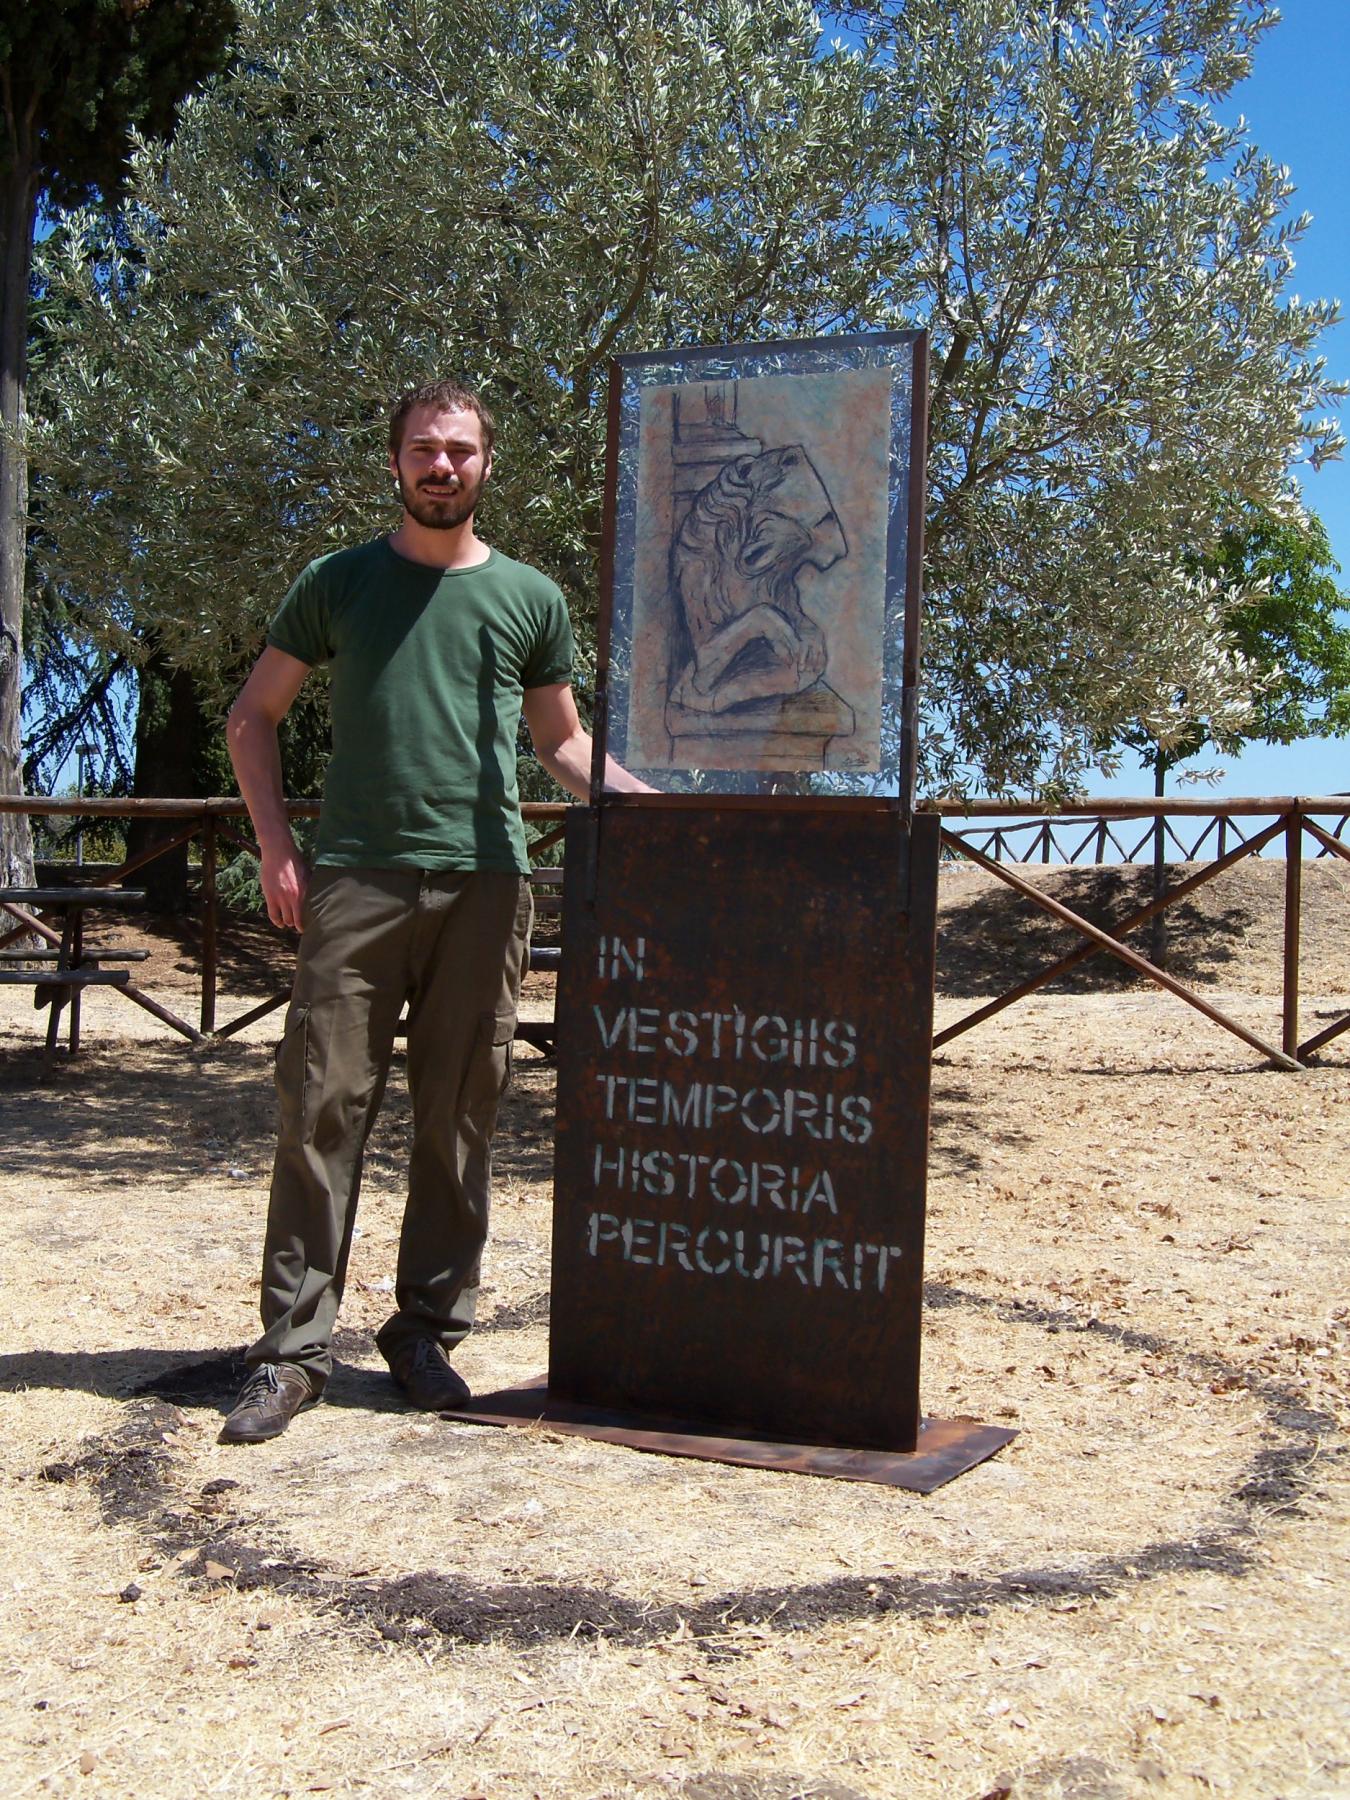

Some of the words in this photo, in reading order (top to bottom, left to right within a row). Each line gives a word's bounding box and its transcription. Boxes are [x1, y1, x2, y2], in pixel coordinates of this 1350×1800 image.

[598, 936, 646, 981] IN
[593, 1004, 857, 1068] VESTIGIIS
[596, 1074, 873, 1144] TEMPORIS
[593, 1144, 839, 1215] HISTORIA
[587, 1212, 902, 1292] PERCURRIT
